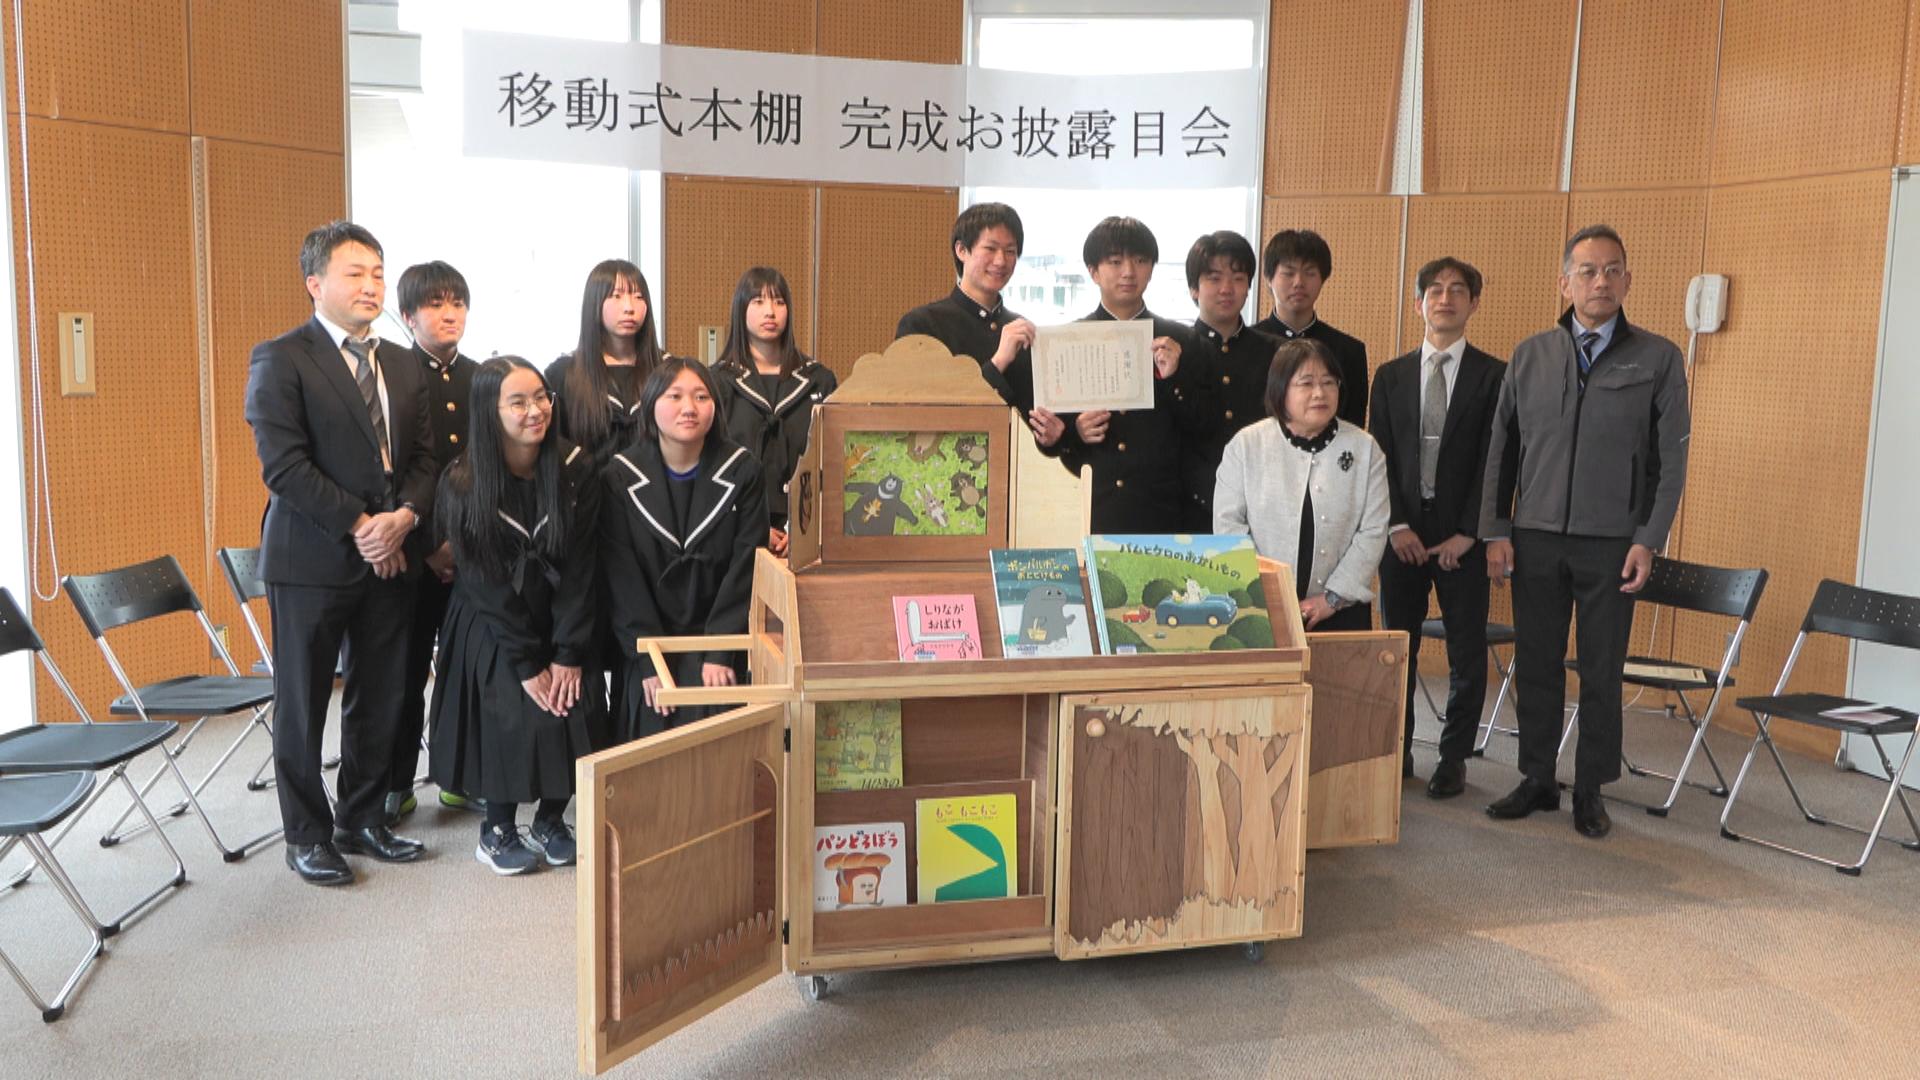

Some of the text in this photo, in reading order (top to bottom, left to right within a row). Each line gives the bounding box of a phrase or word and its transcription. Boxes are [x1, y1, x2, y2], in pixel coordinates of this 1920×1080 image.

[498, 71, 1232, 160] 移動式本棚 完成お披露目会
[925, 604, 964, 615] しりなが
[928, 618, 961, 630] おばけ
[936, 804, 998, 819] もこ もこもこ
[816, 830, 898, 852] パンどろぼう
